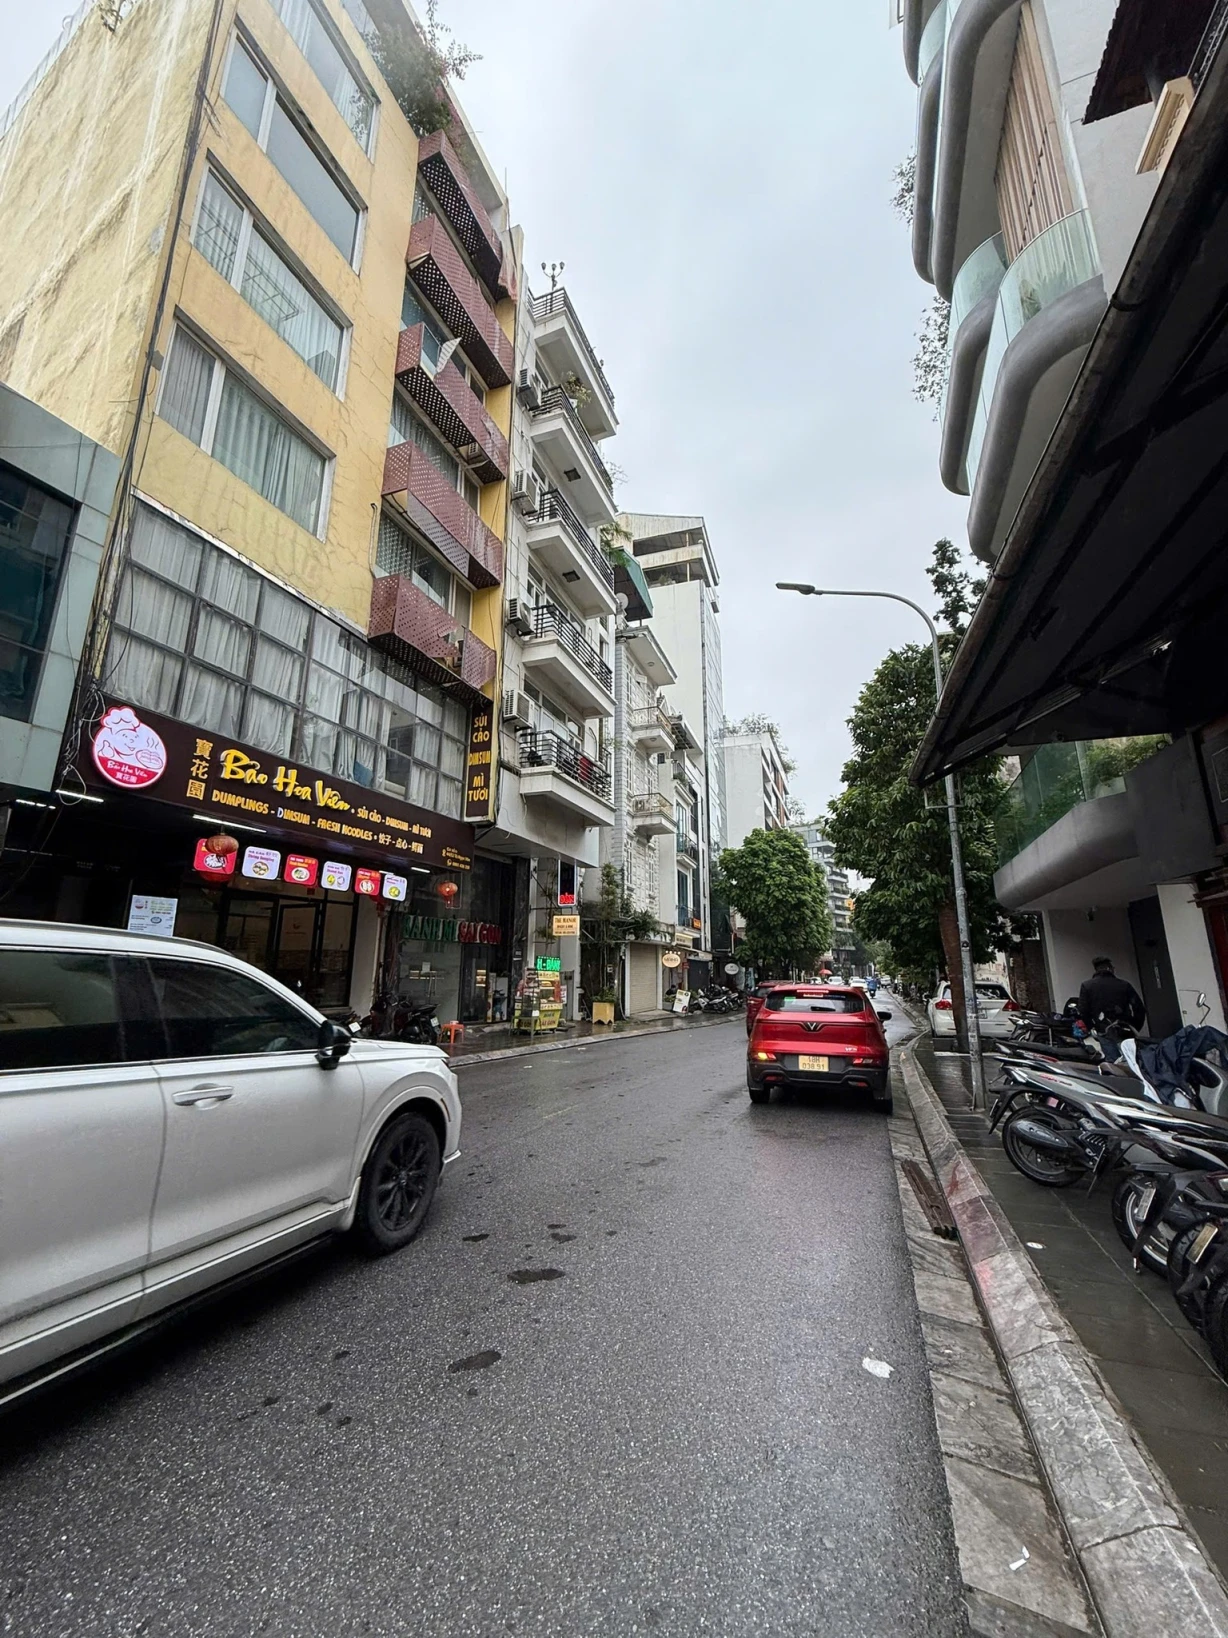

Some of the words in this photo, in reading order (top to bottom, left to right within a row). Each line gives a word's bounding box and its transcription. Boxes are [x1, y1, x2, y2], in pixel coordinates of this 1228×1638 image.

[474, 712, 488, 728] SỦI
[472, 727, 490, 743] CẢO
[469, 750, 491, 766] DIMSUM
[220, 749, 269, 784] Bảo
[272, 766, 312, 801] Hoa
[315, 780, 351, 811] Viên
[473, 772, 484, 787] MÌ
[468, 787, 489, 802] TƯƠI
[211, 789, 269, 815] DUMPLINGS
[277, 807, 310, 825] DIMSUM
[317, 818, 341, 833] FRESH
[342, 824, 373, 841] NOODLES
[357, 806, 369, 819] SỦI
[369, 809, 382, 823] CẢO
